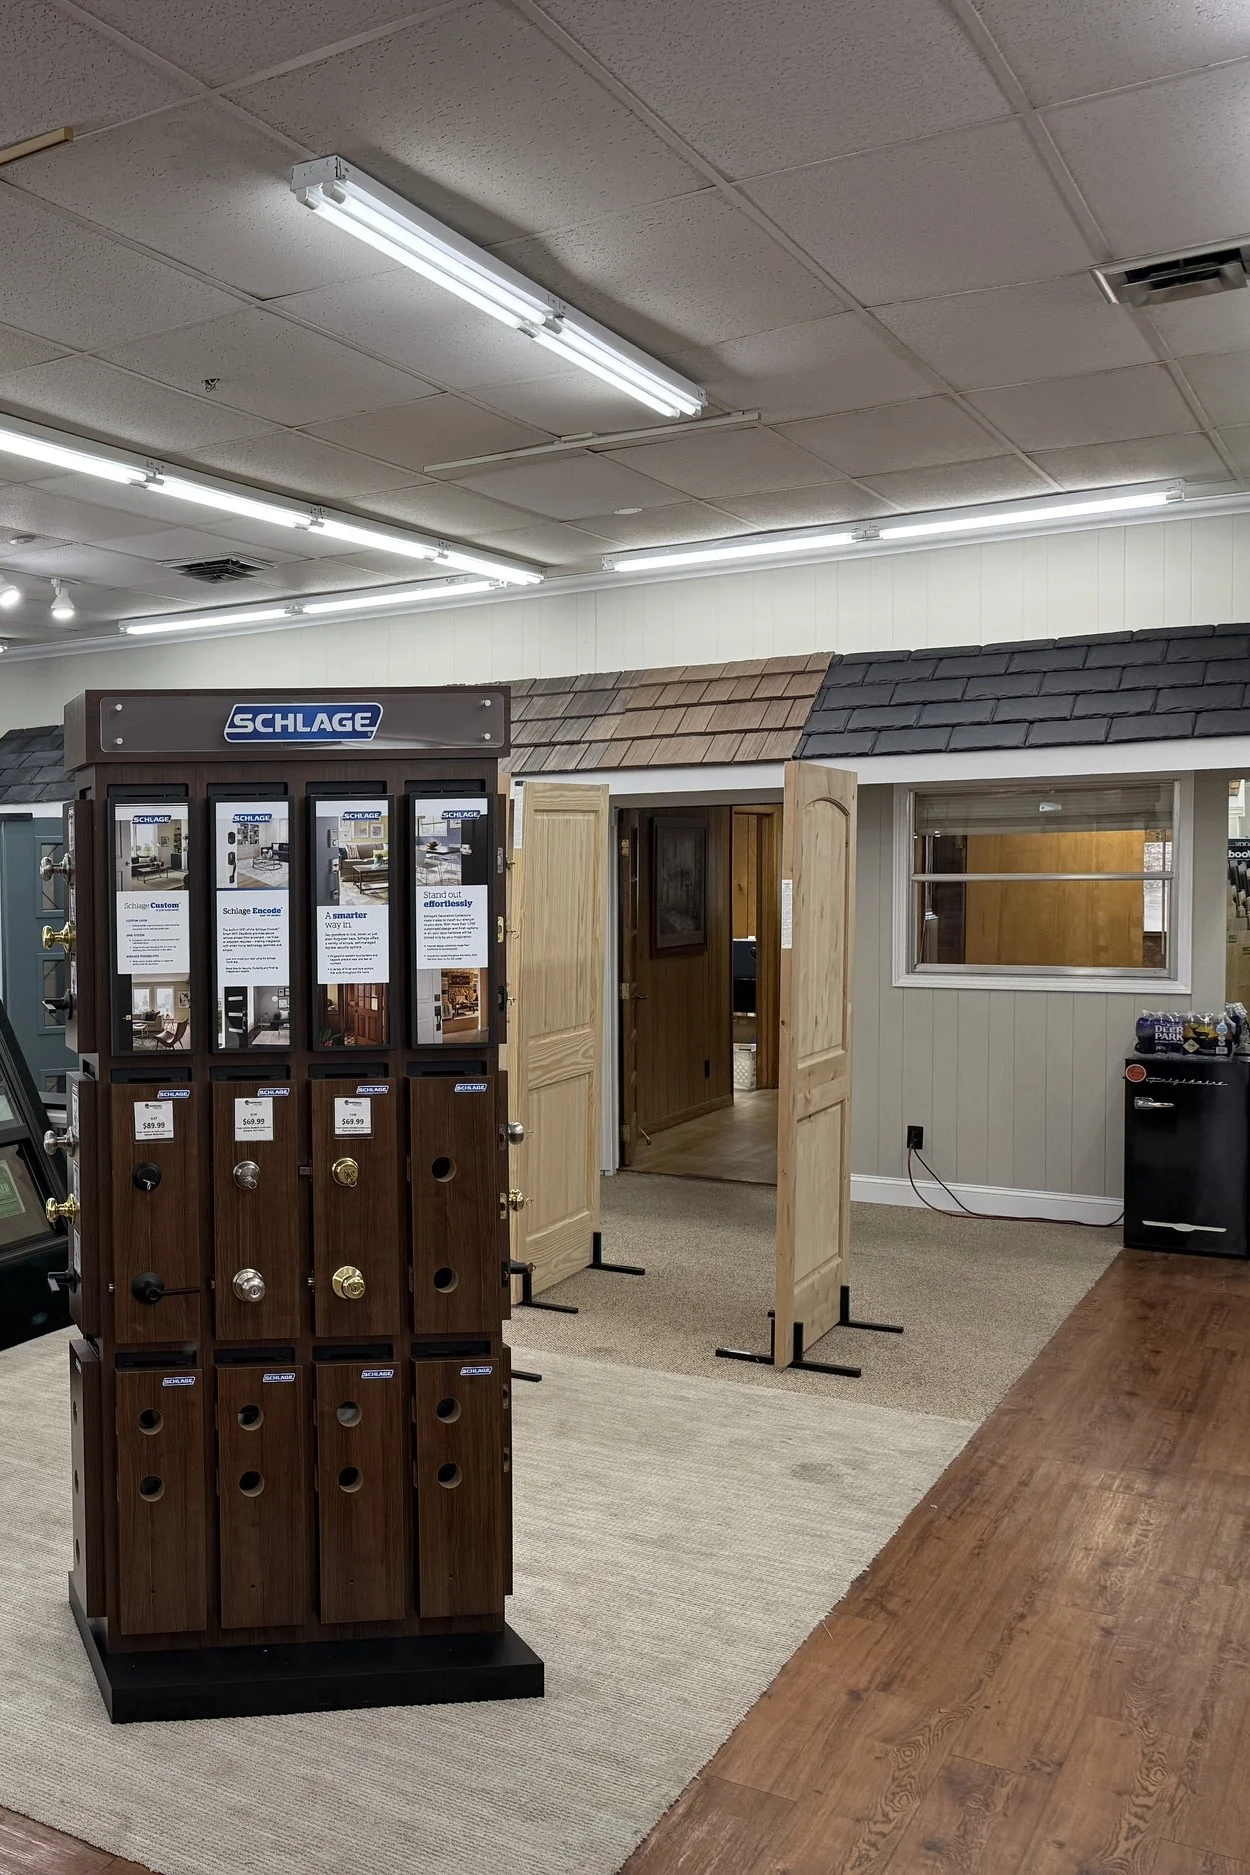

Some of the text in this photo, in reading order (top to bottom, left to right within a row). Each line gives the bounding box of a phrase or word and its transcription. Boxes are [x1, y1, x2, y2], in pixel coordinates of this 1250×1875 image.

[227, 712, 375, 733] SCHLAGE
[124, 902, 149, 910] Schlage
[424, 900, 473, 908] effortlessly
[1155, 1025, 1183, 1033] DEER
[1146, 1078, 1228, 1086] Frigidaire
